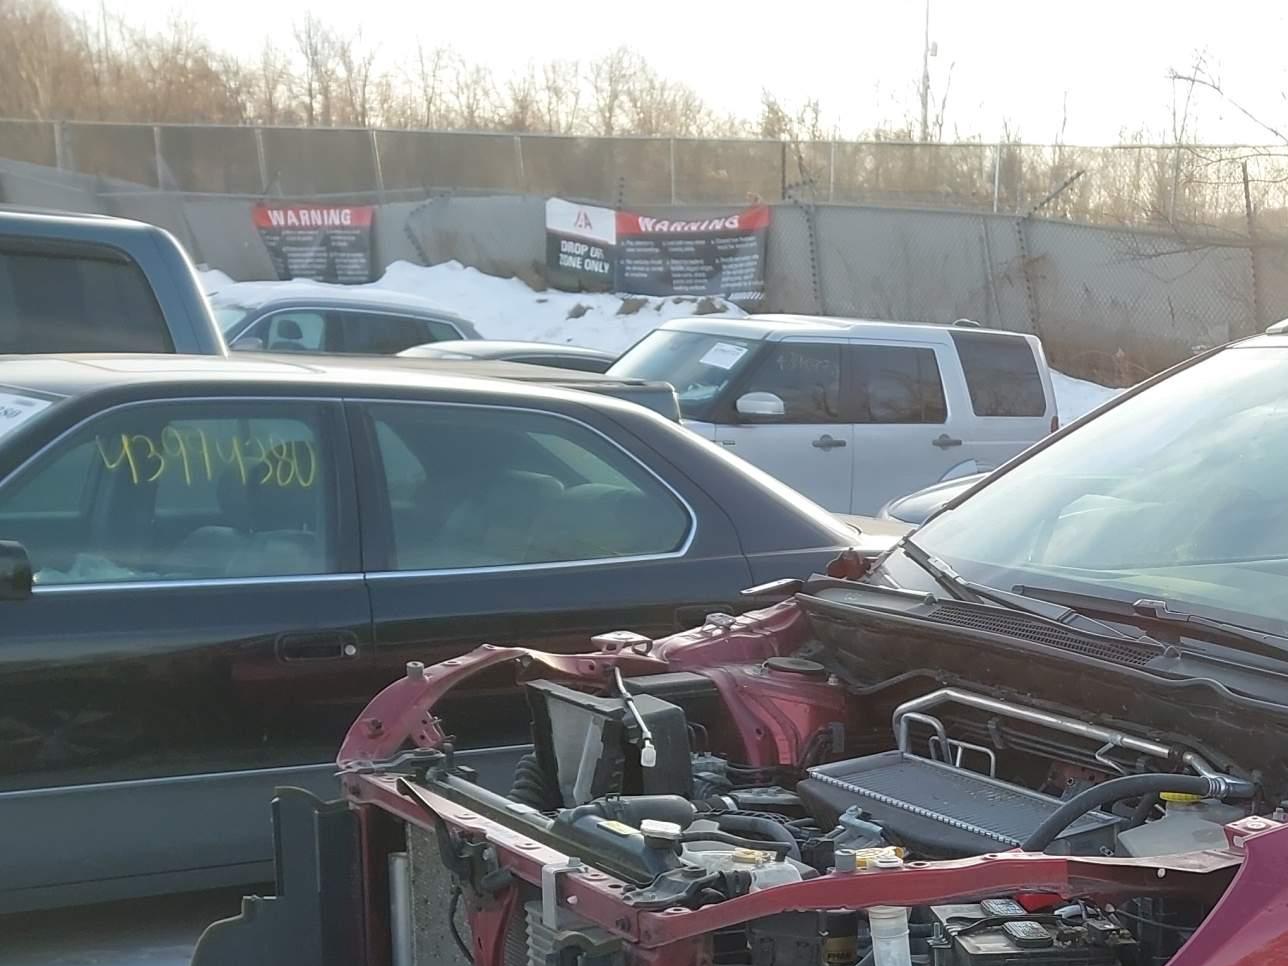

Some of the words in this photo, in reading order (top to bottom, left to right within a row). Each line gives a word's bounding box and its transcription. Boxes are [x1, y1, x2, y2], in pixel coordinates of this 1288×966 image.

[267, 208, 352, 227] WARNING
[637, 215, 739, 232] WARNING
[560, 240, 589, 256] DROP
[559, 253, 583, 270] ZONE
[583, 258, 610, 274] ONLY
